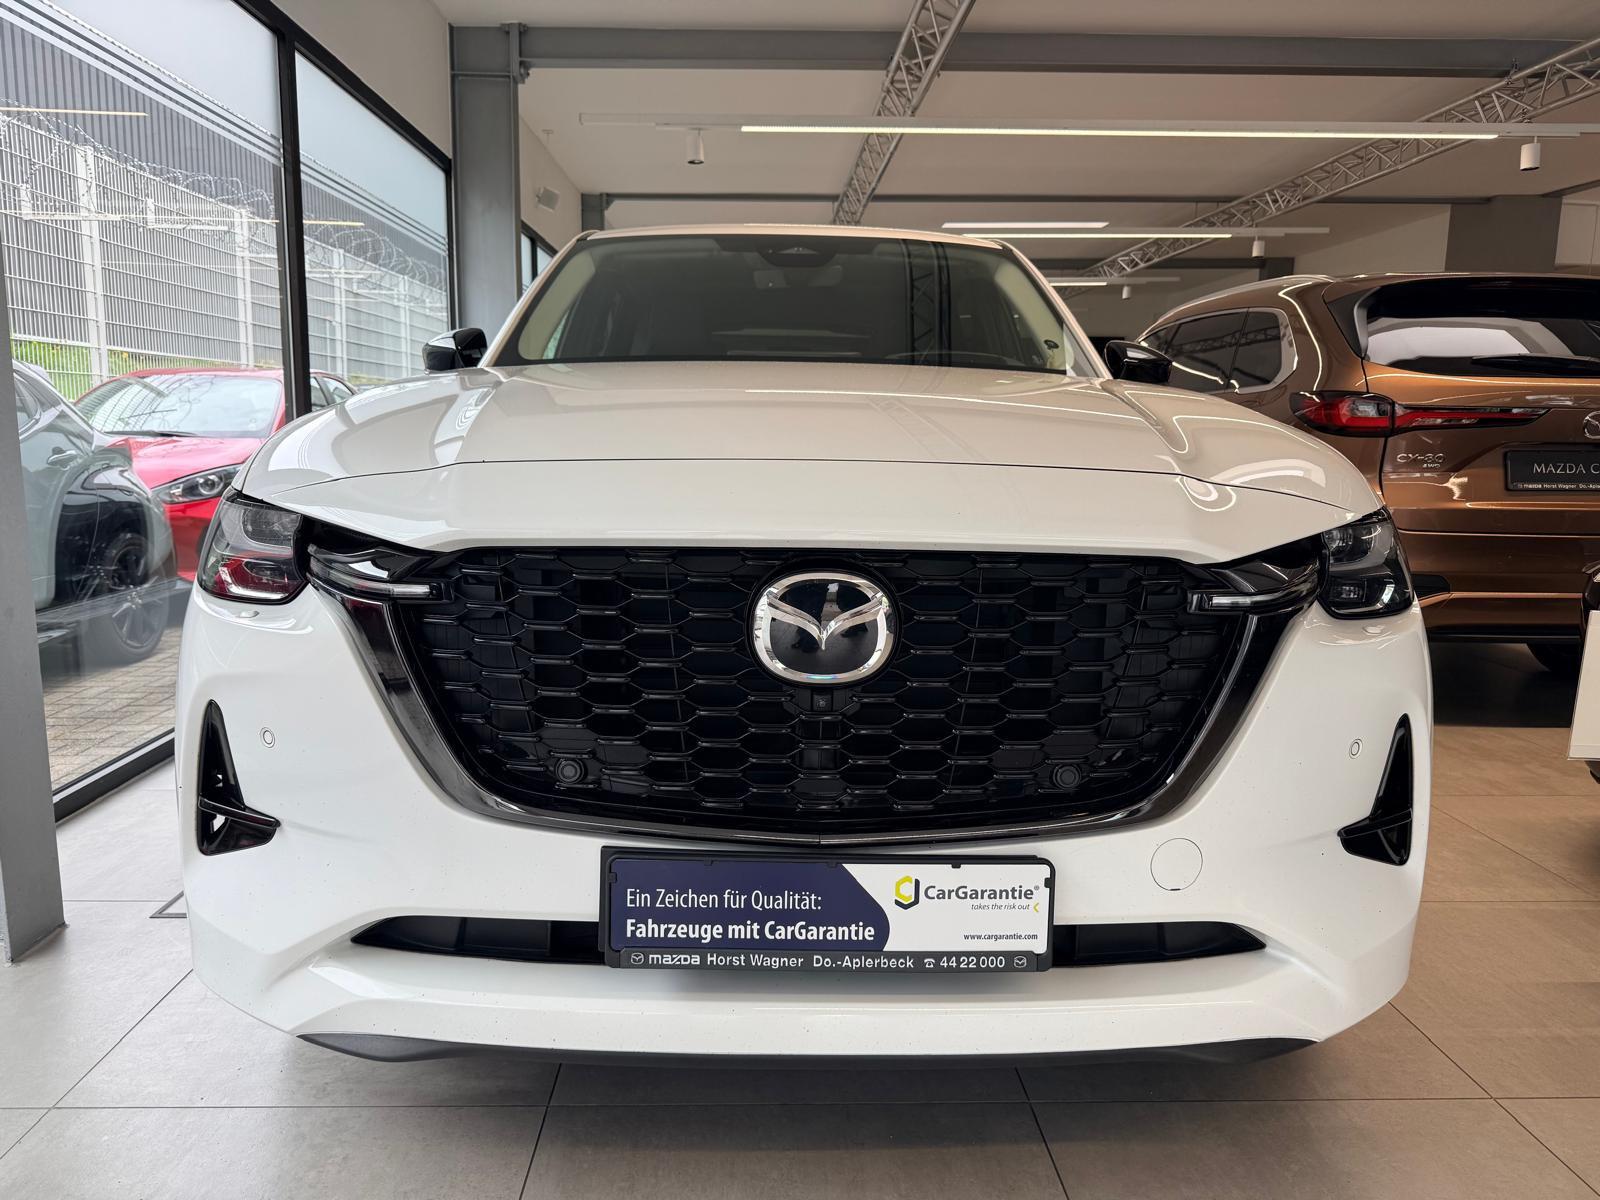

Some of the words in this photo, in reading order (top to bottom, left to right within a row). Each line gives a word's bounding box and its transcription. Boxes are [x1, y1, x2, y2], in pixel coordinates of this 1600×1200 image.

[1533, 463, 1586, 474] MAZDA
[626, 889, 650, 908] Ein
[655, 889, 719, 909] Zeichen
[722, 889, 747, 909] für
[751, 891, 823, 911] Qualität:
[971, 902, 990, 911] takes
[991, 902, 1003, 911] the
[1004, 902, 1016, 911] risk
[1017, 903, 1030, 911] out
[626, 918, 723, 944] Fahrzeuge
[727, 920, 760, 940] mit
[764, 920, 876, 941] CarGarantie
[963, 932, 1039, 942] www.cargarantie.com
[706, 953, 746, 966] Horst
[750, 954, 804, 969] Wagner
[812, 955, 914, 970] Do.-Aplerbeck
